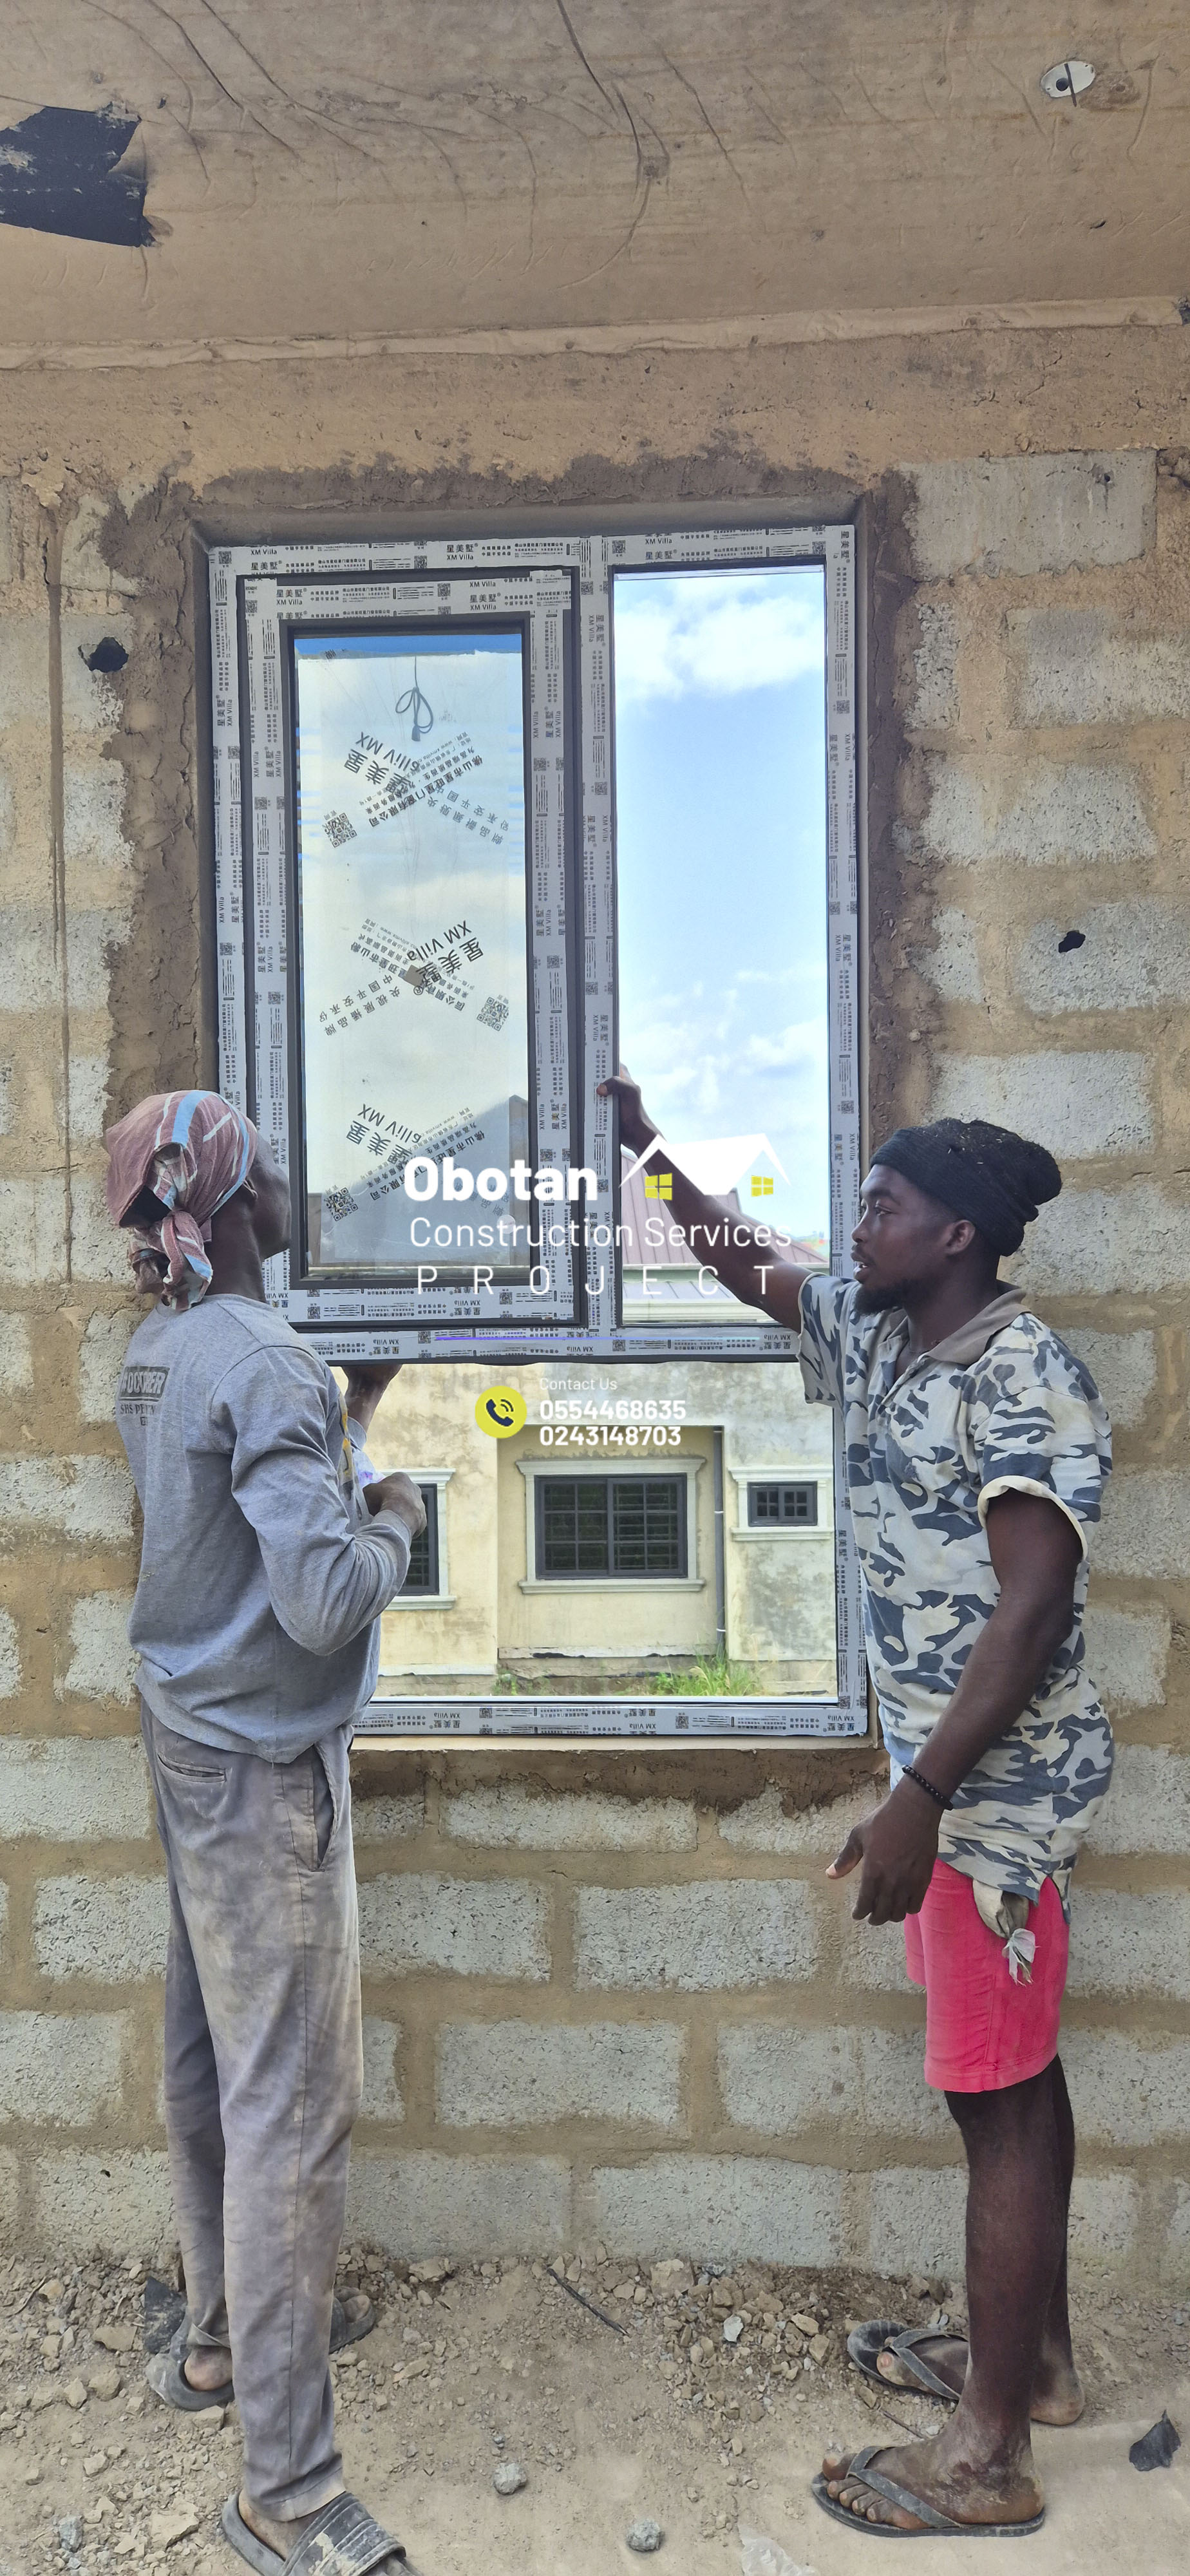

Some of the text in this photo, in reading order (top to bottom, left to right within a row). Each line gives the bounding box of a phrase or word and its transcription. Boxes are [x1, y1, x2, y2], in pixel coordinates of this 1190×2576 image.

[324, 986, 401, 1036] 央视展播品牌
